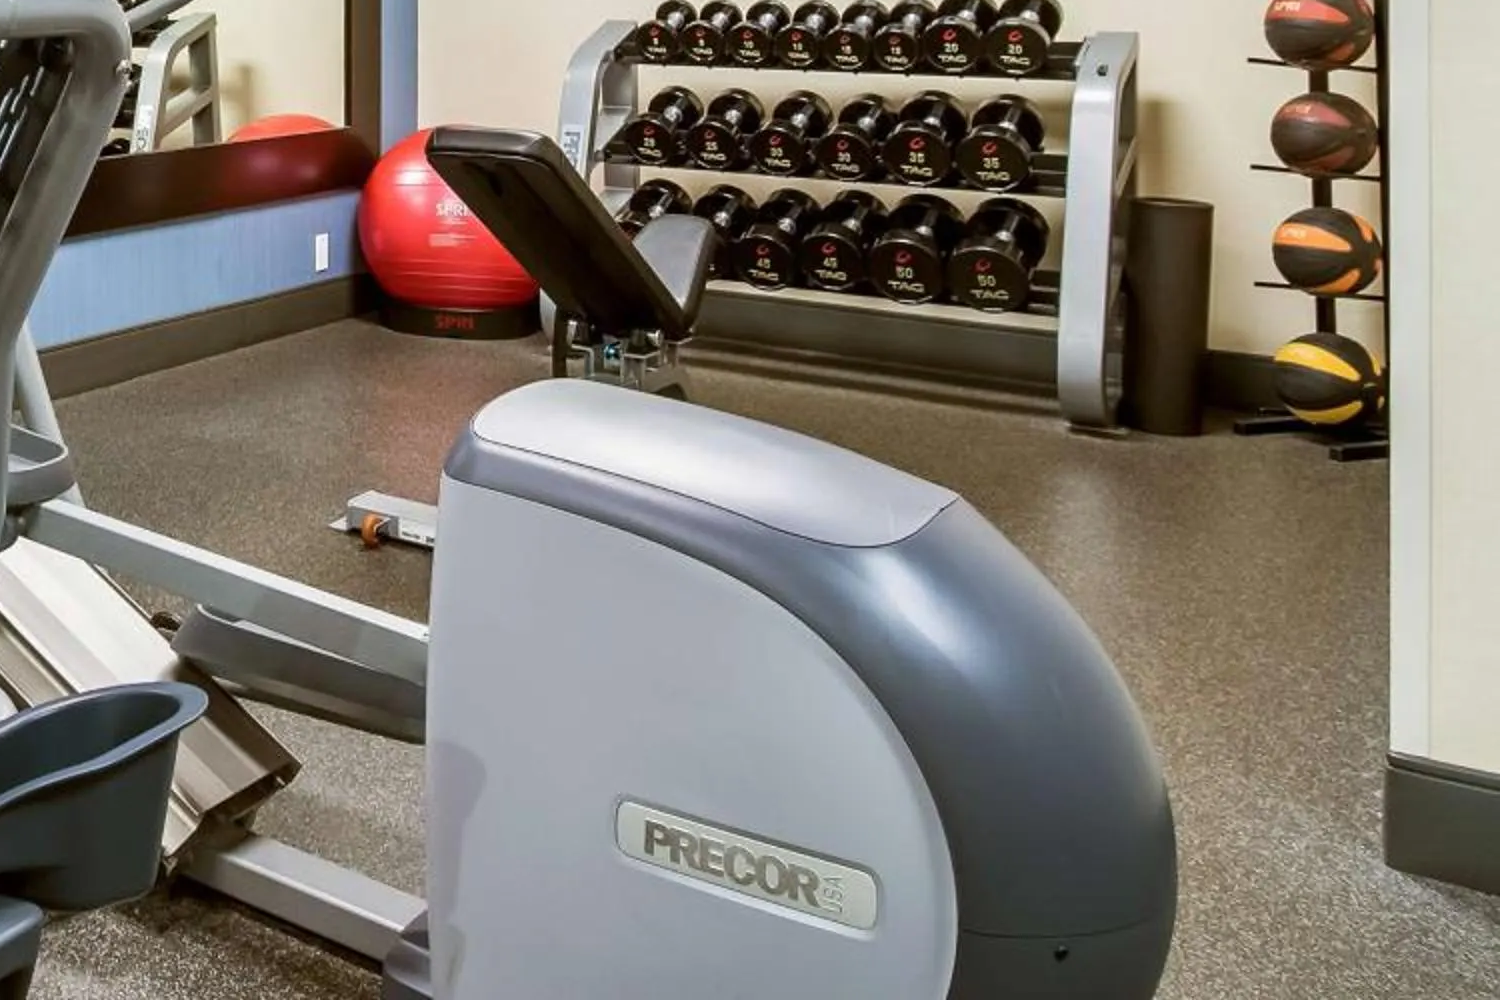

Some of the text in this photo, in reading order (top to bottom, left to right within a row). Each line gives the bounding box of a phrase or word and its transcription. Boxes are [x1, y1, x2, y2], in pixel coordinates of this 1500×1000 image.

[944, 43, 959, 53] 20
[1008, 44, 1023, 54] 20
[938, 54, 968, 63] TAG
[1000, 55, 1030, 65] TAG
[701, 152, 727, 161] TAG
[909, 152, 925, 163] 35
[764, 158, 792, 168] TAG
[831, 163, 860, 173] TAG
[983, 158, 999, 168] 35
[900, 165, 933, 177] TAG
[976, 171, 1011, 181] TAG
[756, 258, 771, 269] 45
[823, 257, 838, 268] 45
[748, 269, 780, 281] TAG
[814, 270, 847, 281] TAG
[895, 266, 913, 279] 50
[977, 274, 996, 287] 50
[887, 280, 925, 293] TAG
[969, 289, 1009, 300] TAG
[435, 315, 475, 330] SPRI
[644, 819, 821, 908] PRECOR
